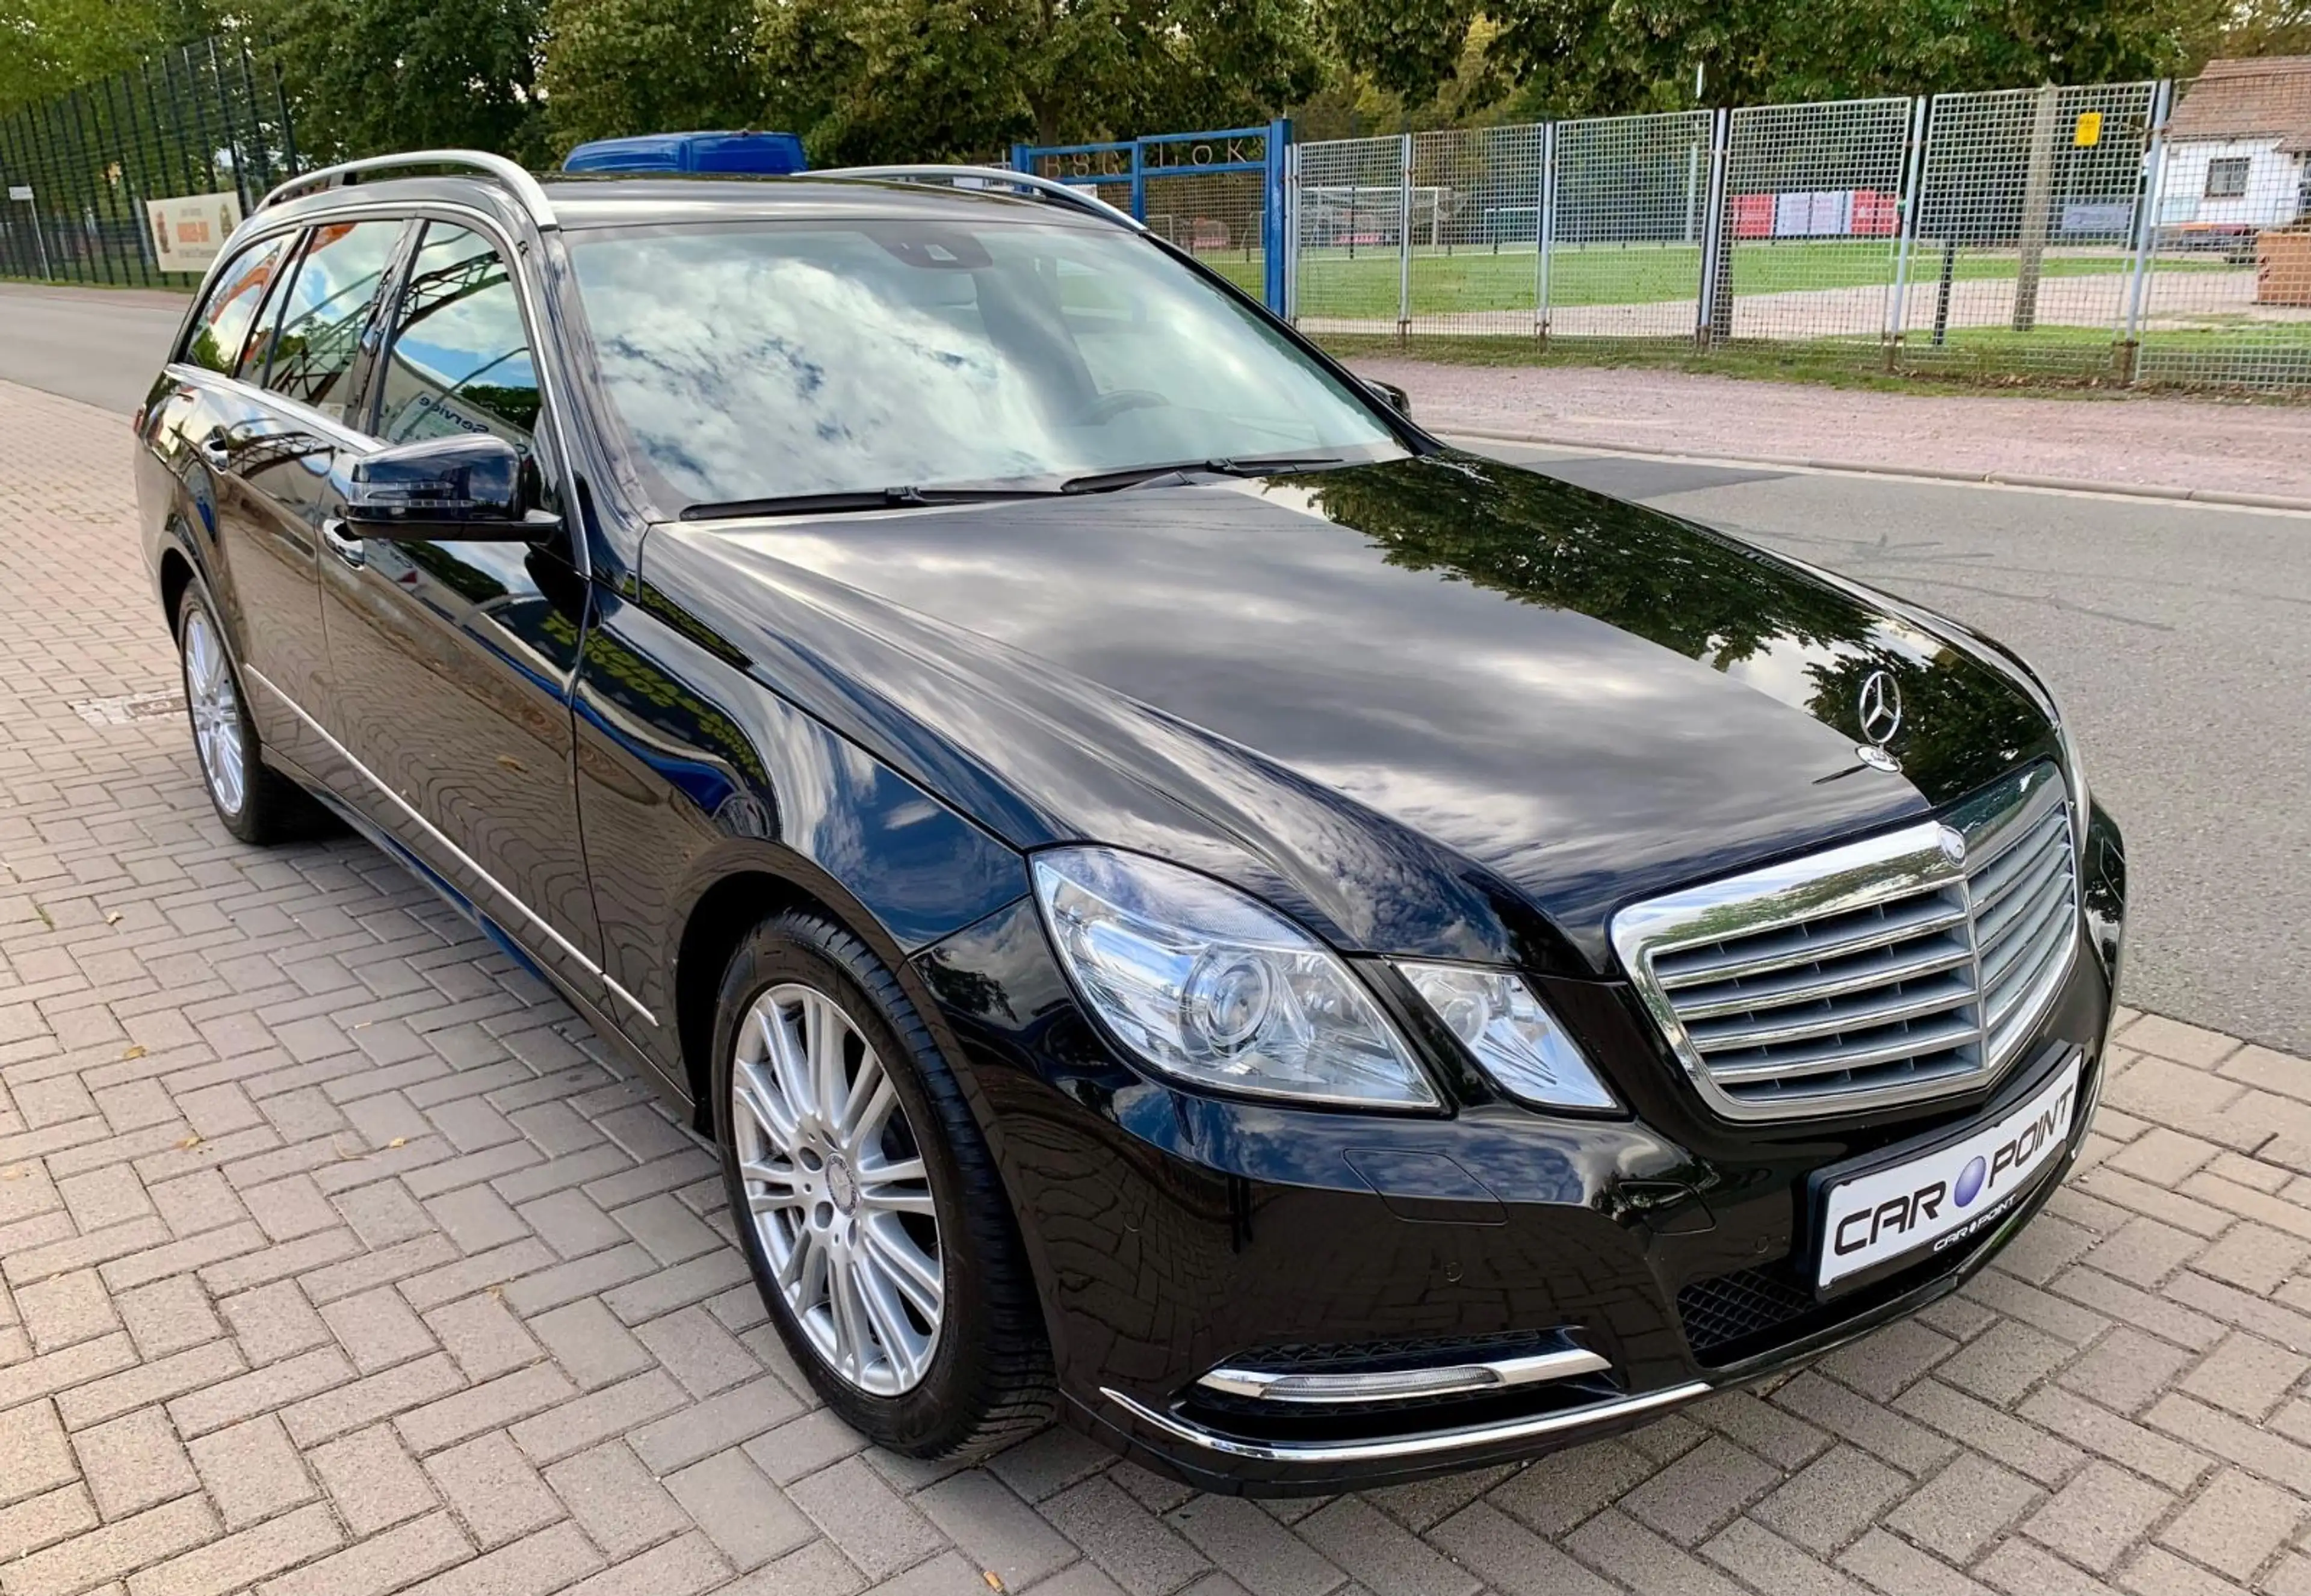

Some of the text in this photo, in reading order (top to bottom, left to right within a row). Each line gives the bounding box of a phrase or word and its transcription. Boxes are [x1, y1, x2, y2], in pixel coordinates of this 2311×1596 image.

[1834, 1084, 2074, 1256] CAR POINT
[1933, 1193, 2016, 1252] CAR POINT
